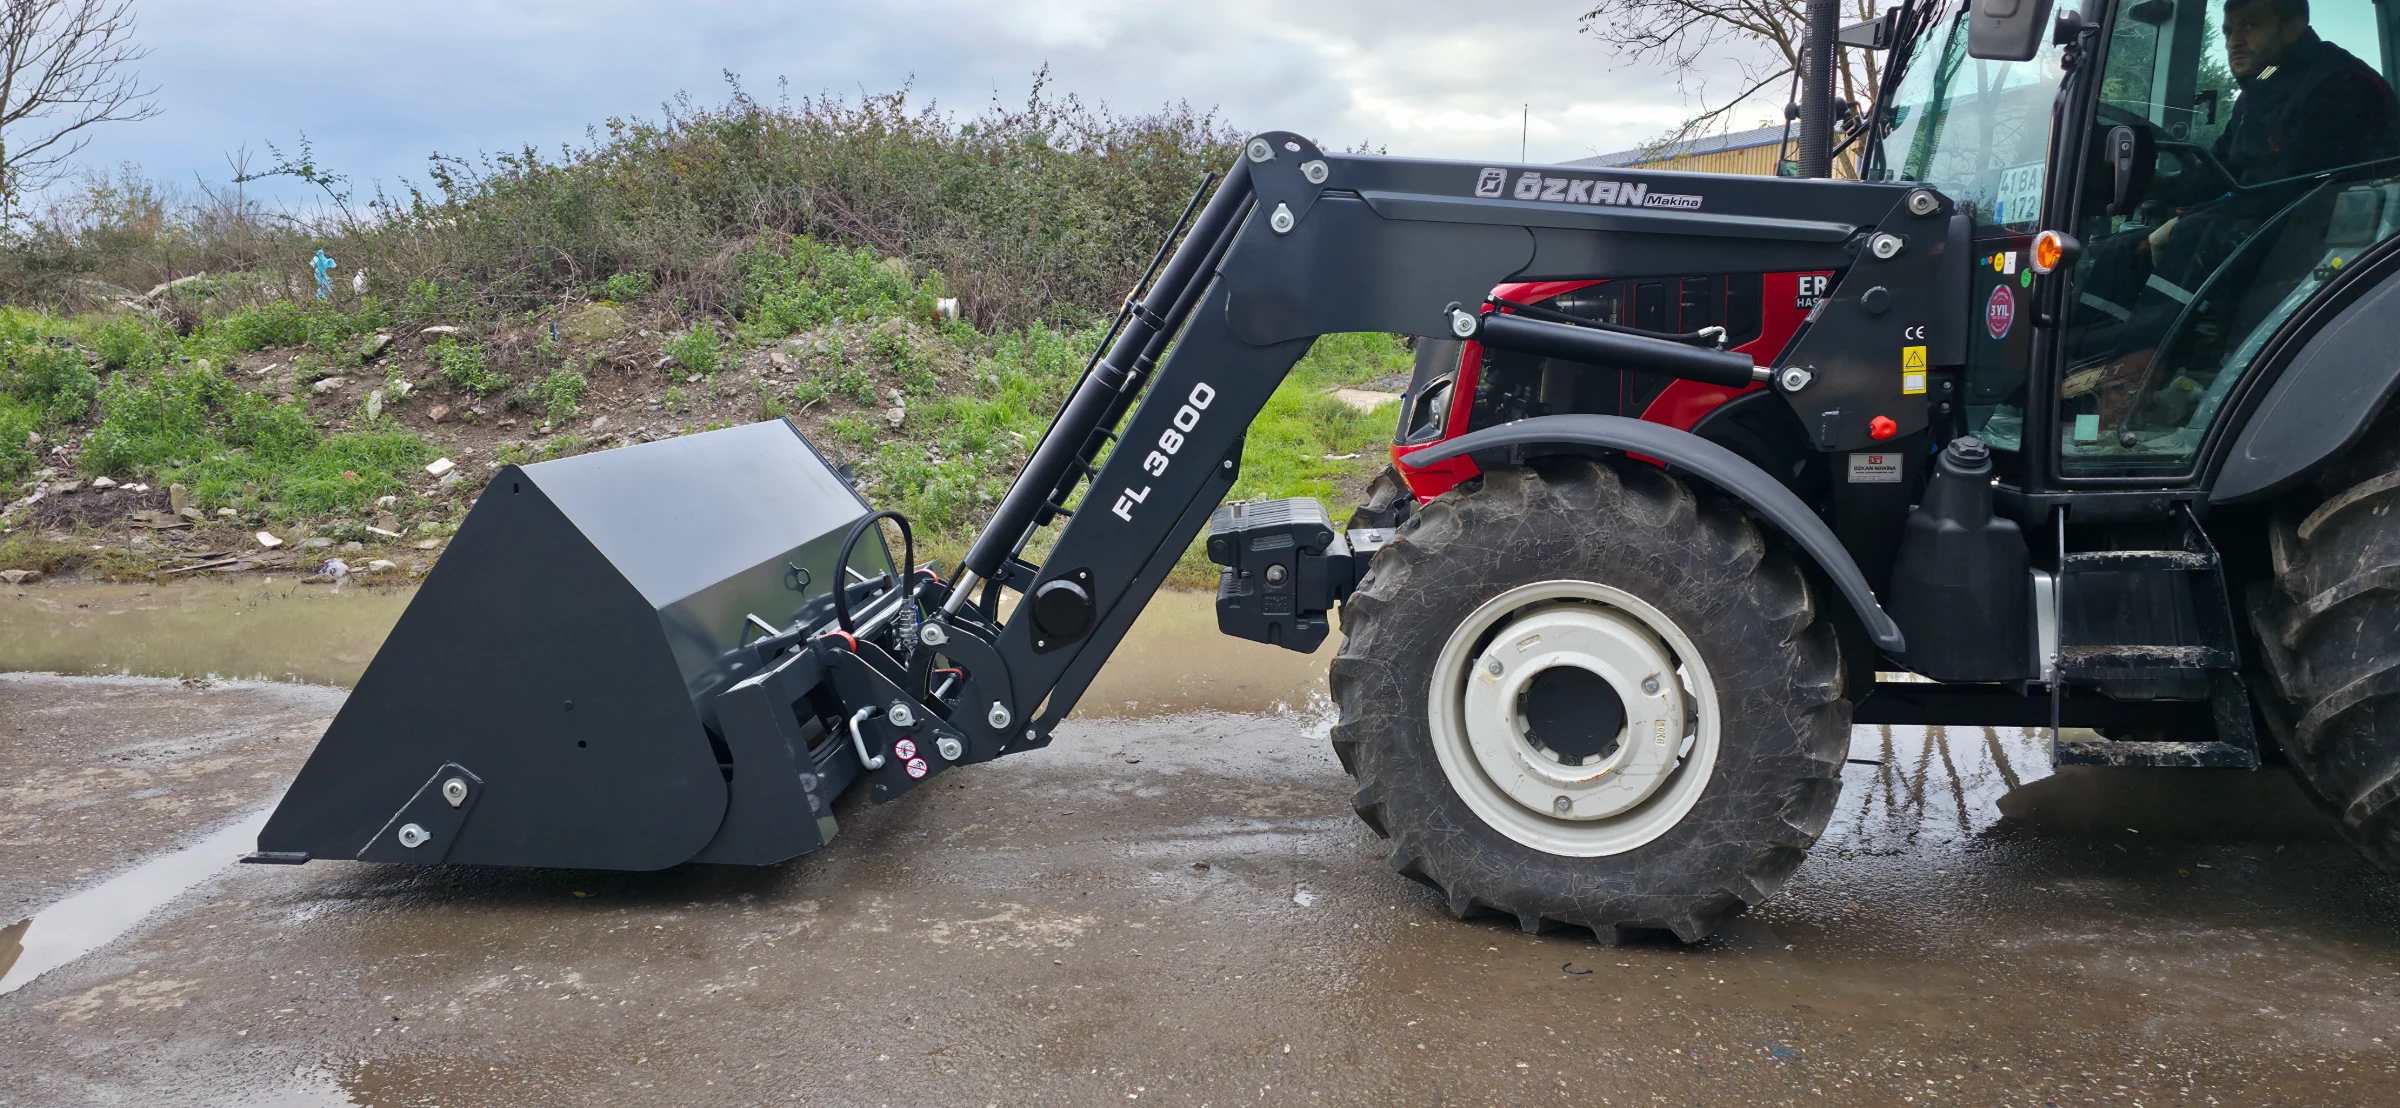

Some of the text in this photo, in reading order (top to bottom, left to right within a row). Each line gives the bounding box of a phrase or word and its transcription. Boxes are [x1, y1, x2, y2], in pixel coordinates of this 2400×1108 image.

[1514, 171, 1648, 206] ÖZKAN
[1646, 195, 1701, 208] Makina
[2011, 195, 2037, 219] 172
[1905, 325, 1925, 340] CE
[1111, 382, 1216, 522] FL 3800
